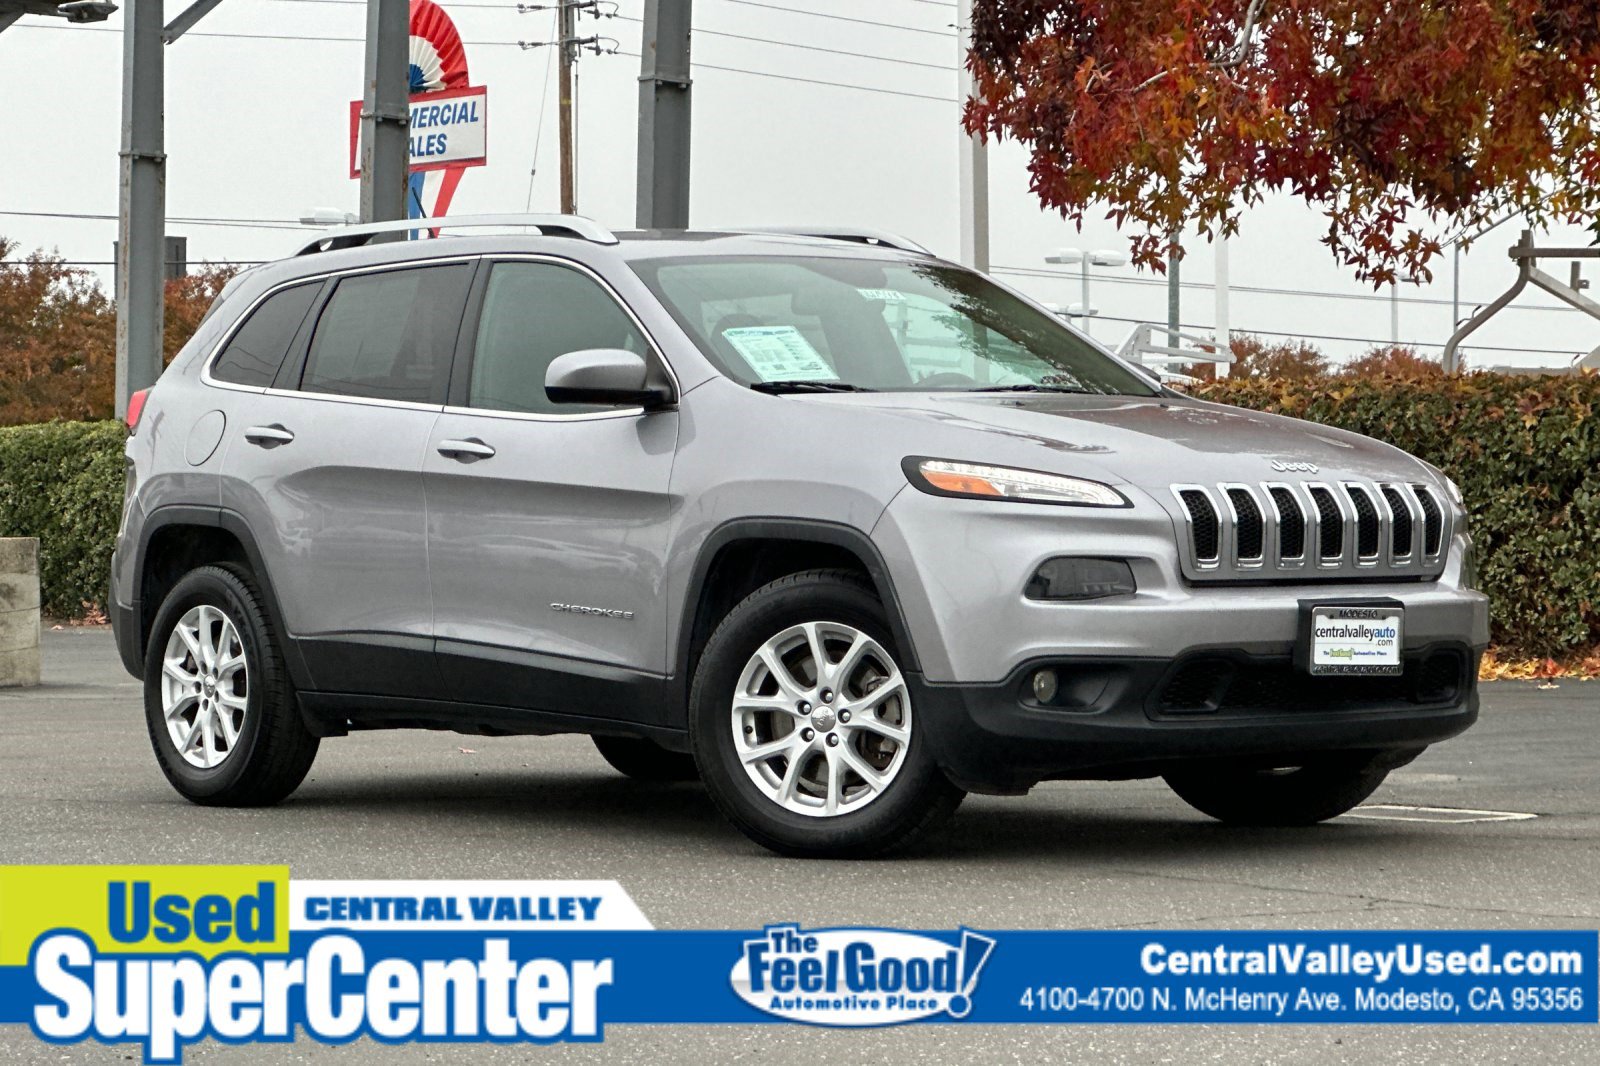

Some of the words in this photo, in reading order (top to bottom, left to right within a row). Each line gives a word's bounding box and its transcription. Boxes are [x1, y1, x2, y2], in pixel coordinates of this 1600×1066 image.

[1271, 460, 1319, 474] Jeep
[550, 603, 634, 620] CHEROKEE
[1315, 625, 1396, 641] centralvalleyauto
[1375, 639, 1393, 647] .com
